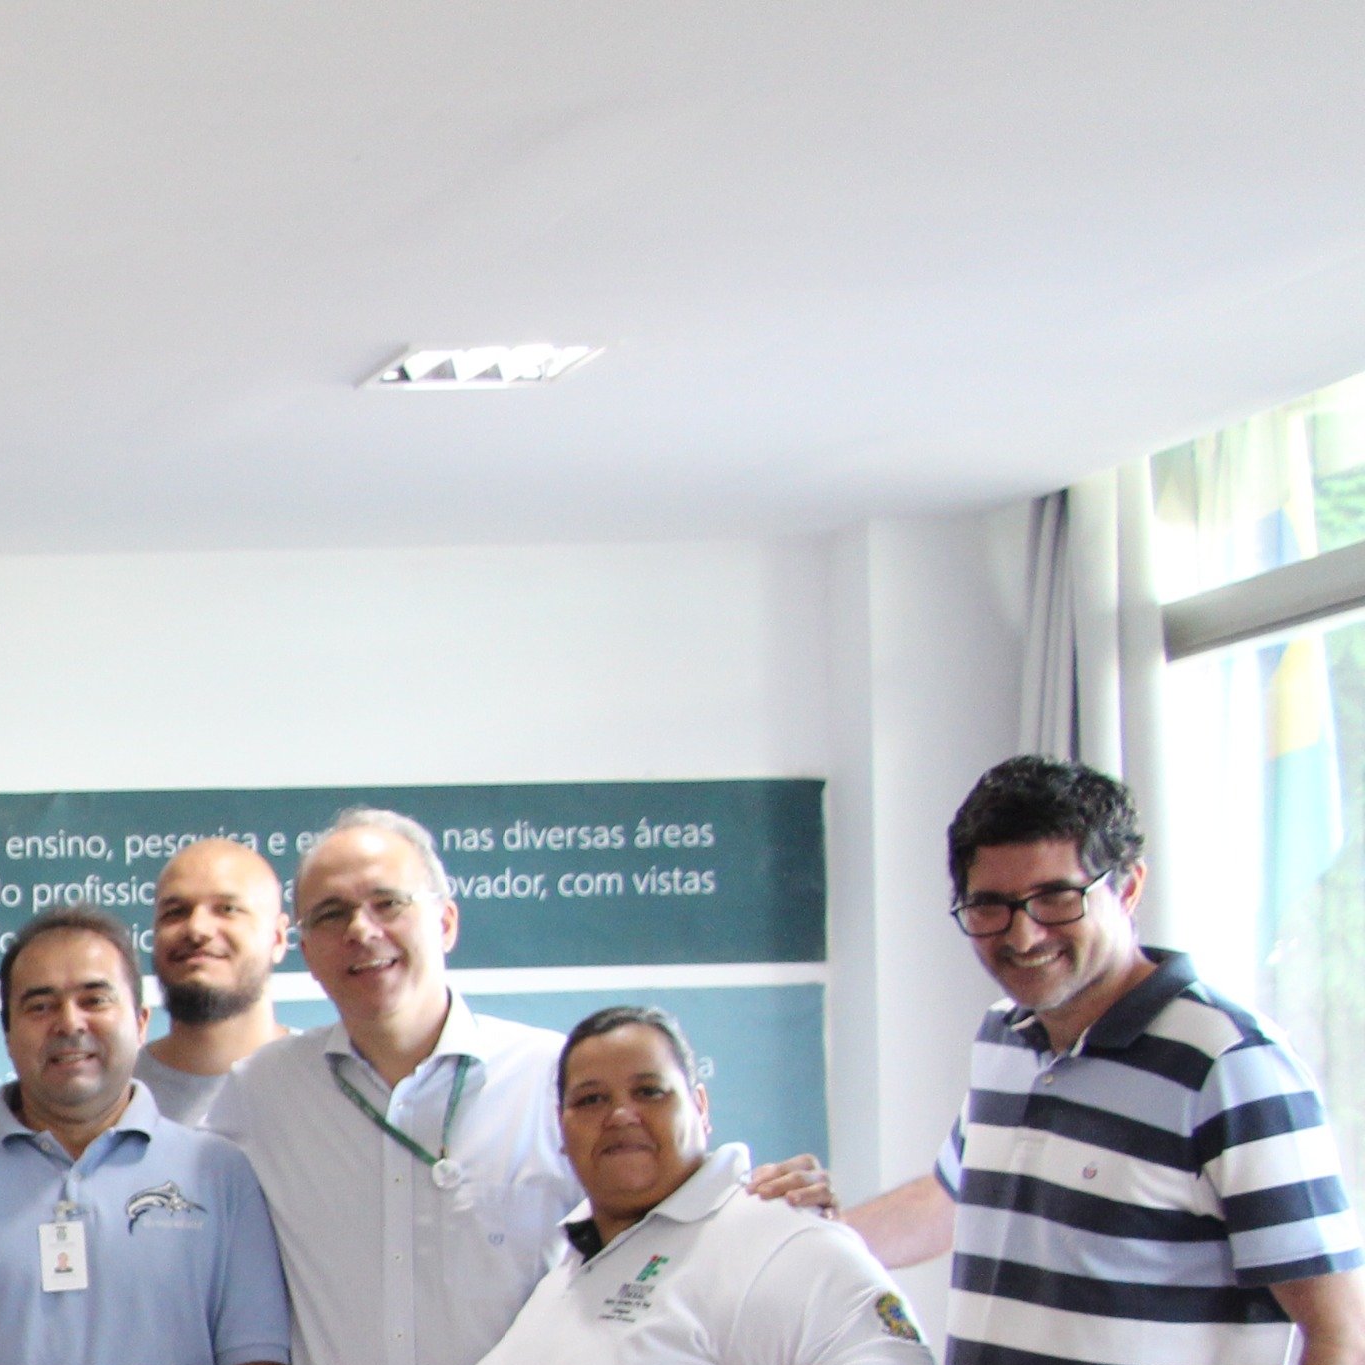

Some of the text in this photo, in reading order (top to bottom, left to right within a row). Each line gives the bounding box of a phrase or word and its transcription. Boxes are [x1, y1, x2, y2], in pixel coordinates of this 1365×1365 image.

[6, 829, 114, 862] ensino,
[267, 831, 286, 856] e
[442, 826, 495, 852] nas
[502, 818, 626, 851] diversas
[633, 816, 716, 849] áreas
[557, 871, 624, 898] com
[631, 865, 717, 896] vistas
